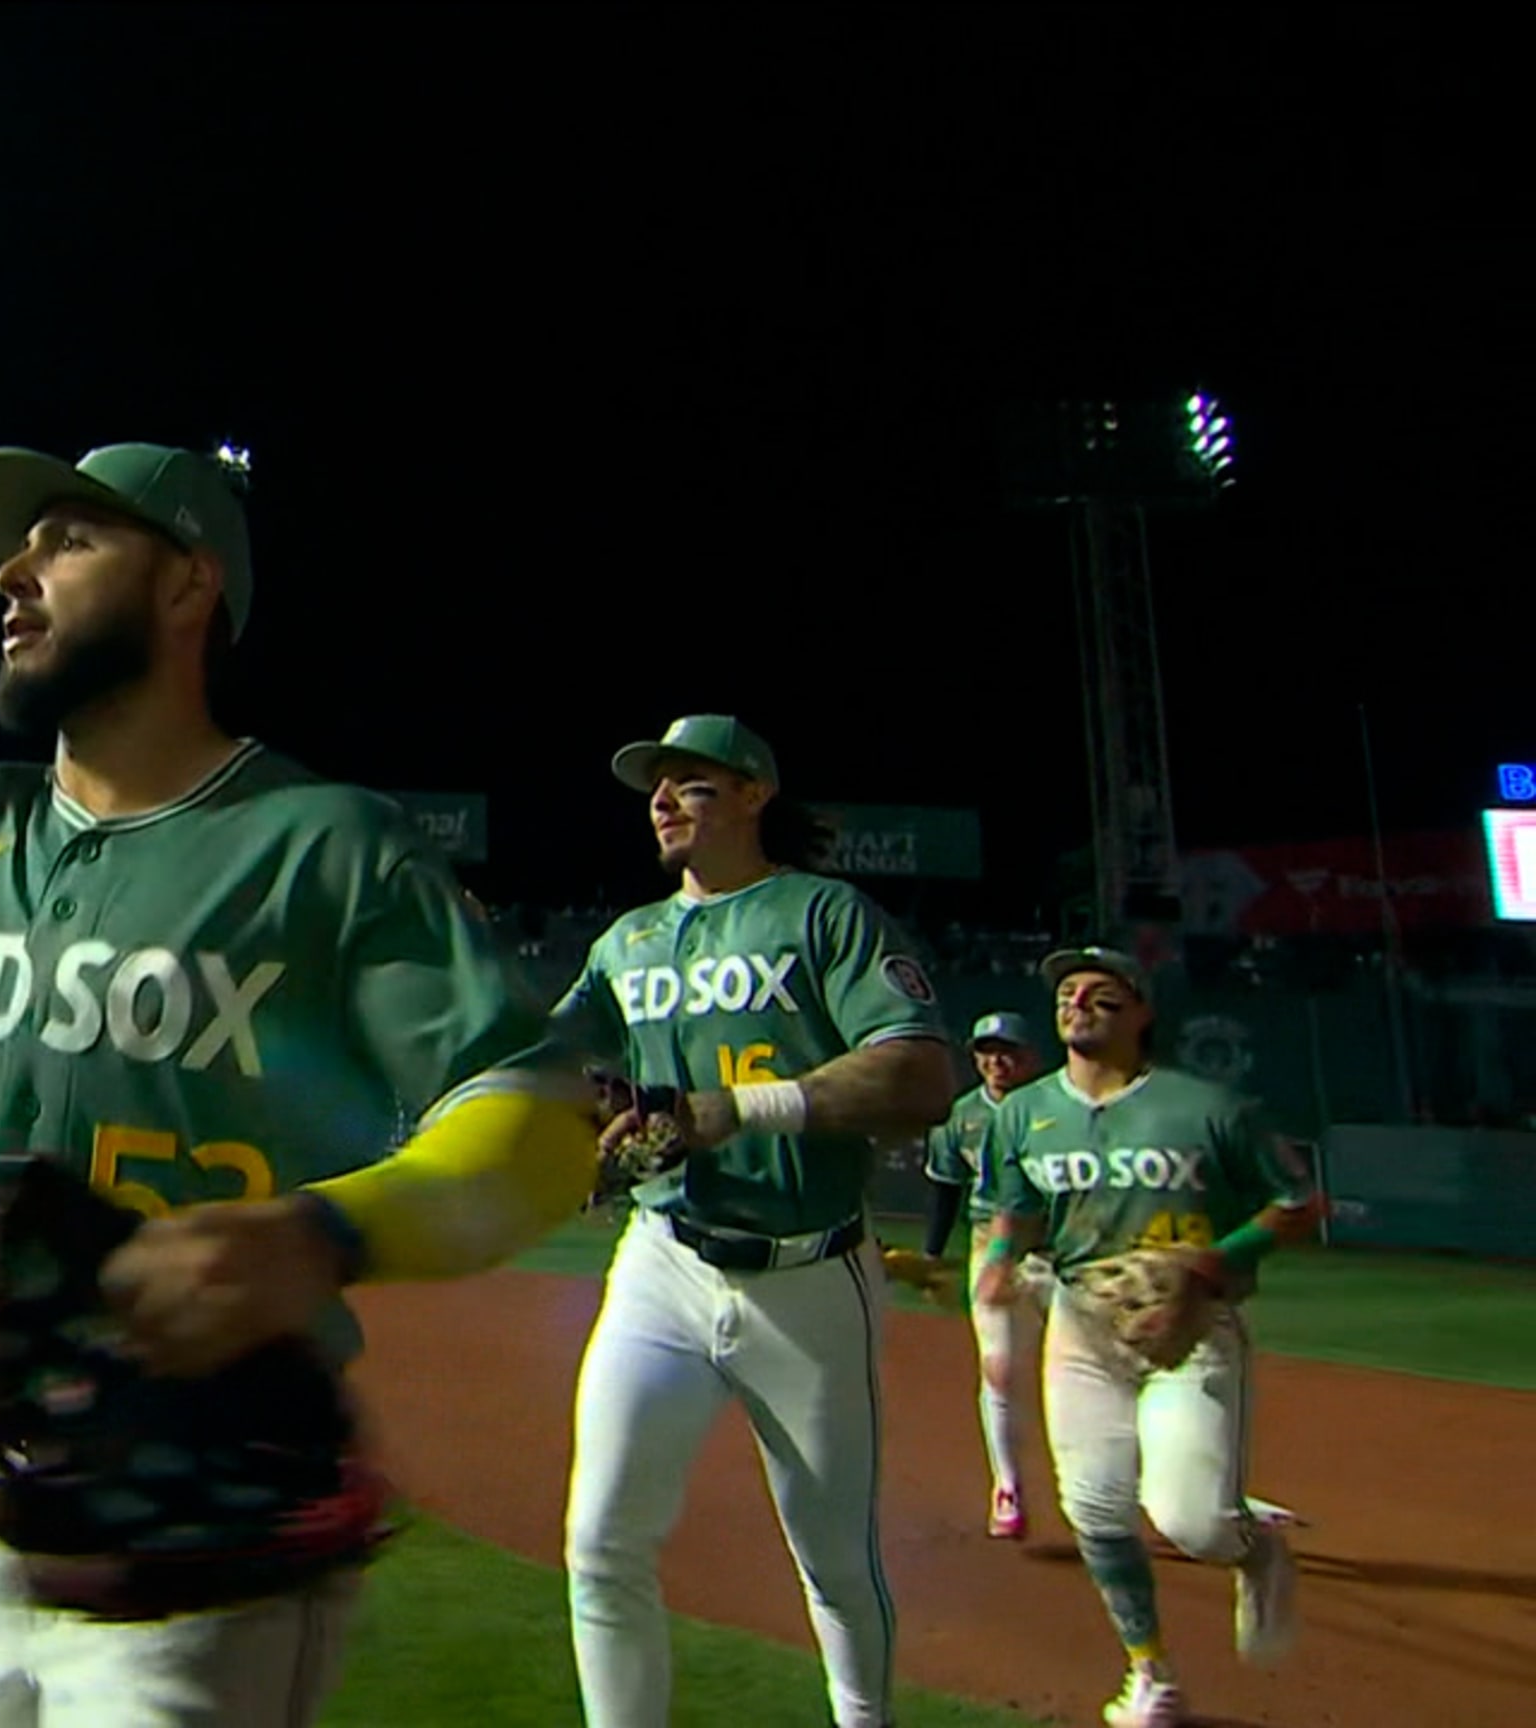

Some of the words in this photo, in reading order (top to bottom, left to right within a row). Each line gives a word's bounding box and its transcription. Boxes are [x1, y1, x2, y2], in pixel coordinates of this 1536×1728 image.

[40, 940, 287, 1078] SOX
[609, 965, 681, 1025] ED
[685, 953, 800, 1015] SOX
[1107, 1147, 1207, 1192] SOX
